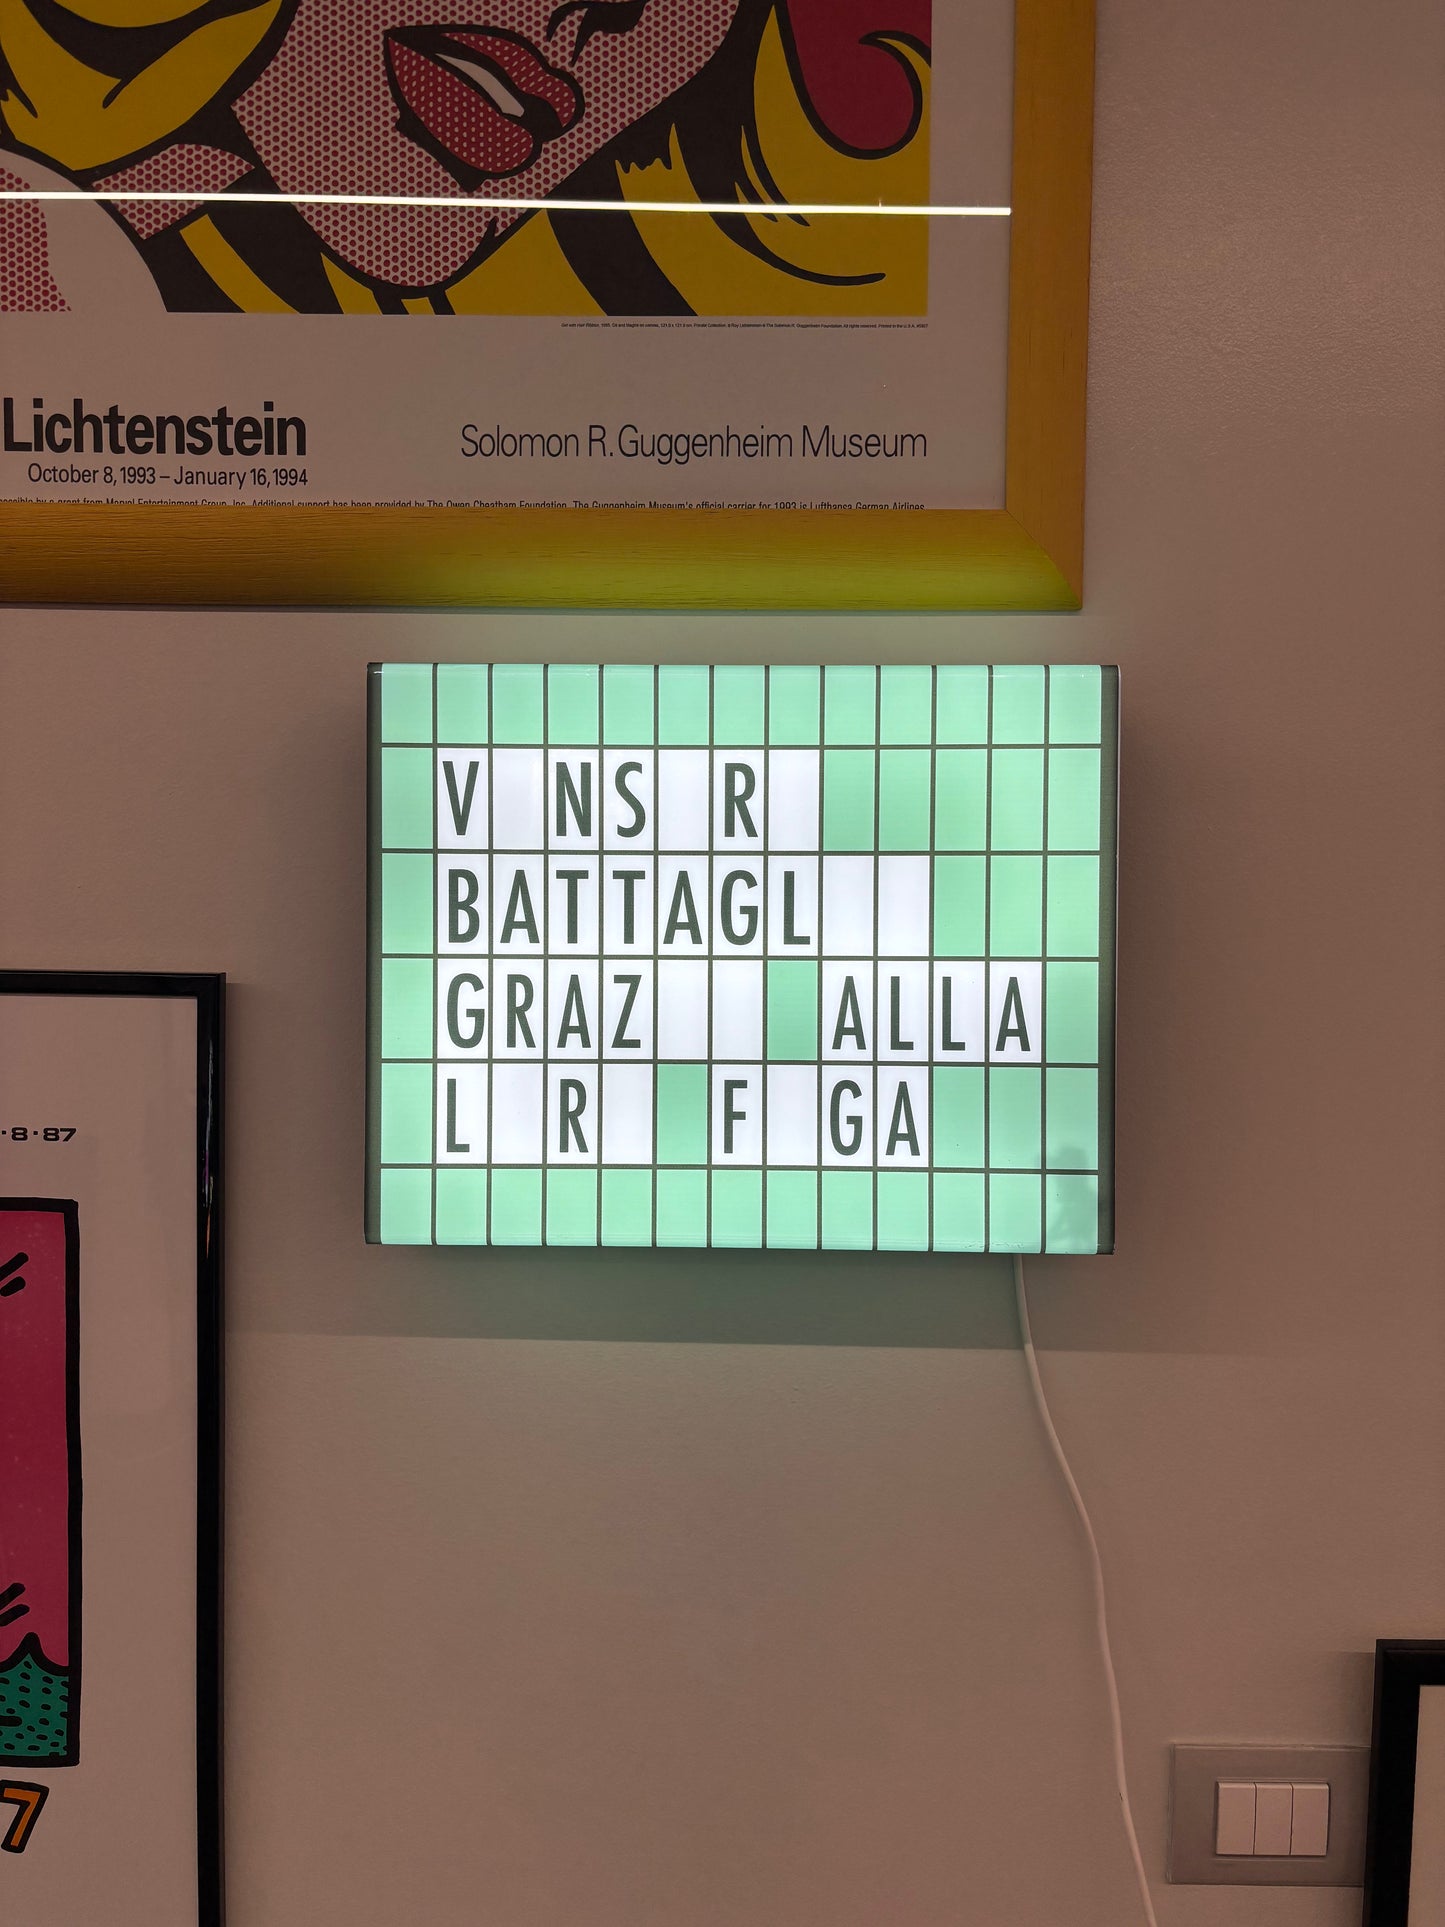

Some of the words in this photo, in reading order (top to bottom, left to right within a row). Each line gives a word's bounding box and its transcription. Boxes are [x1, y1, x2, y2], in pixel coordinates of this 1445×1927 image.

[3, 397, 307, 456] Lichtenstein
[461, 423, 579, 458] Solomon
[802, 424, 927, 458] Museum
[27, 462, 100, 484] October
[173, 465, 247, 491] January
[442, 760, 480, 836] V
[556, 761, 646, 838] NS
[724, 762, 759, 838] R
[448, 868, 811, 946] BATTAGL
[446, 973, 642, 1049] GRAZ
[831, 975, 1031, 1052] ALLA
[446, 1078, 470, 1153] L
[559, 1078, 589, 1153] R
[723, 1079, 748, 1154] F
[829, 1079, 921, 1156] GA
[0, 1779, 50, 1853] 7
